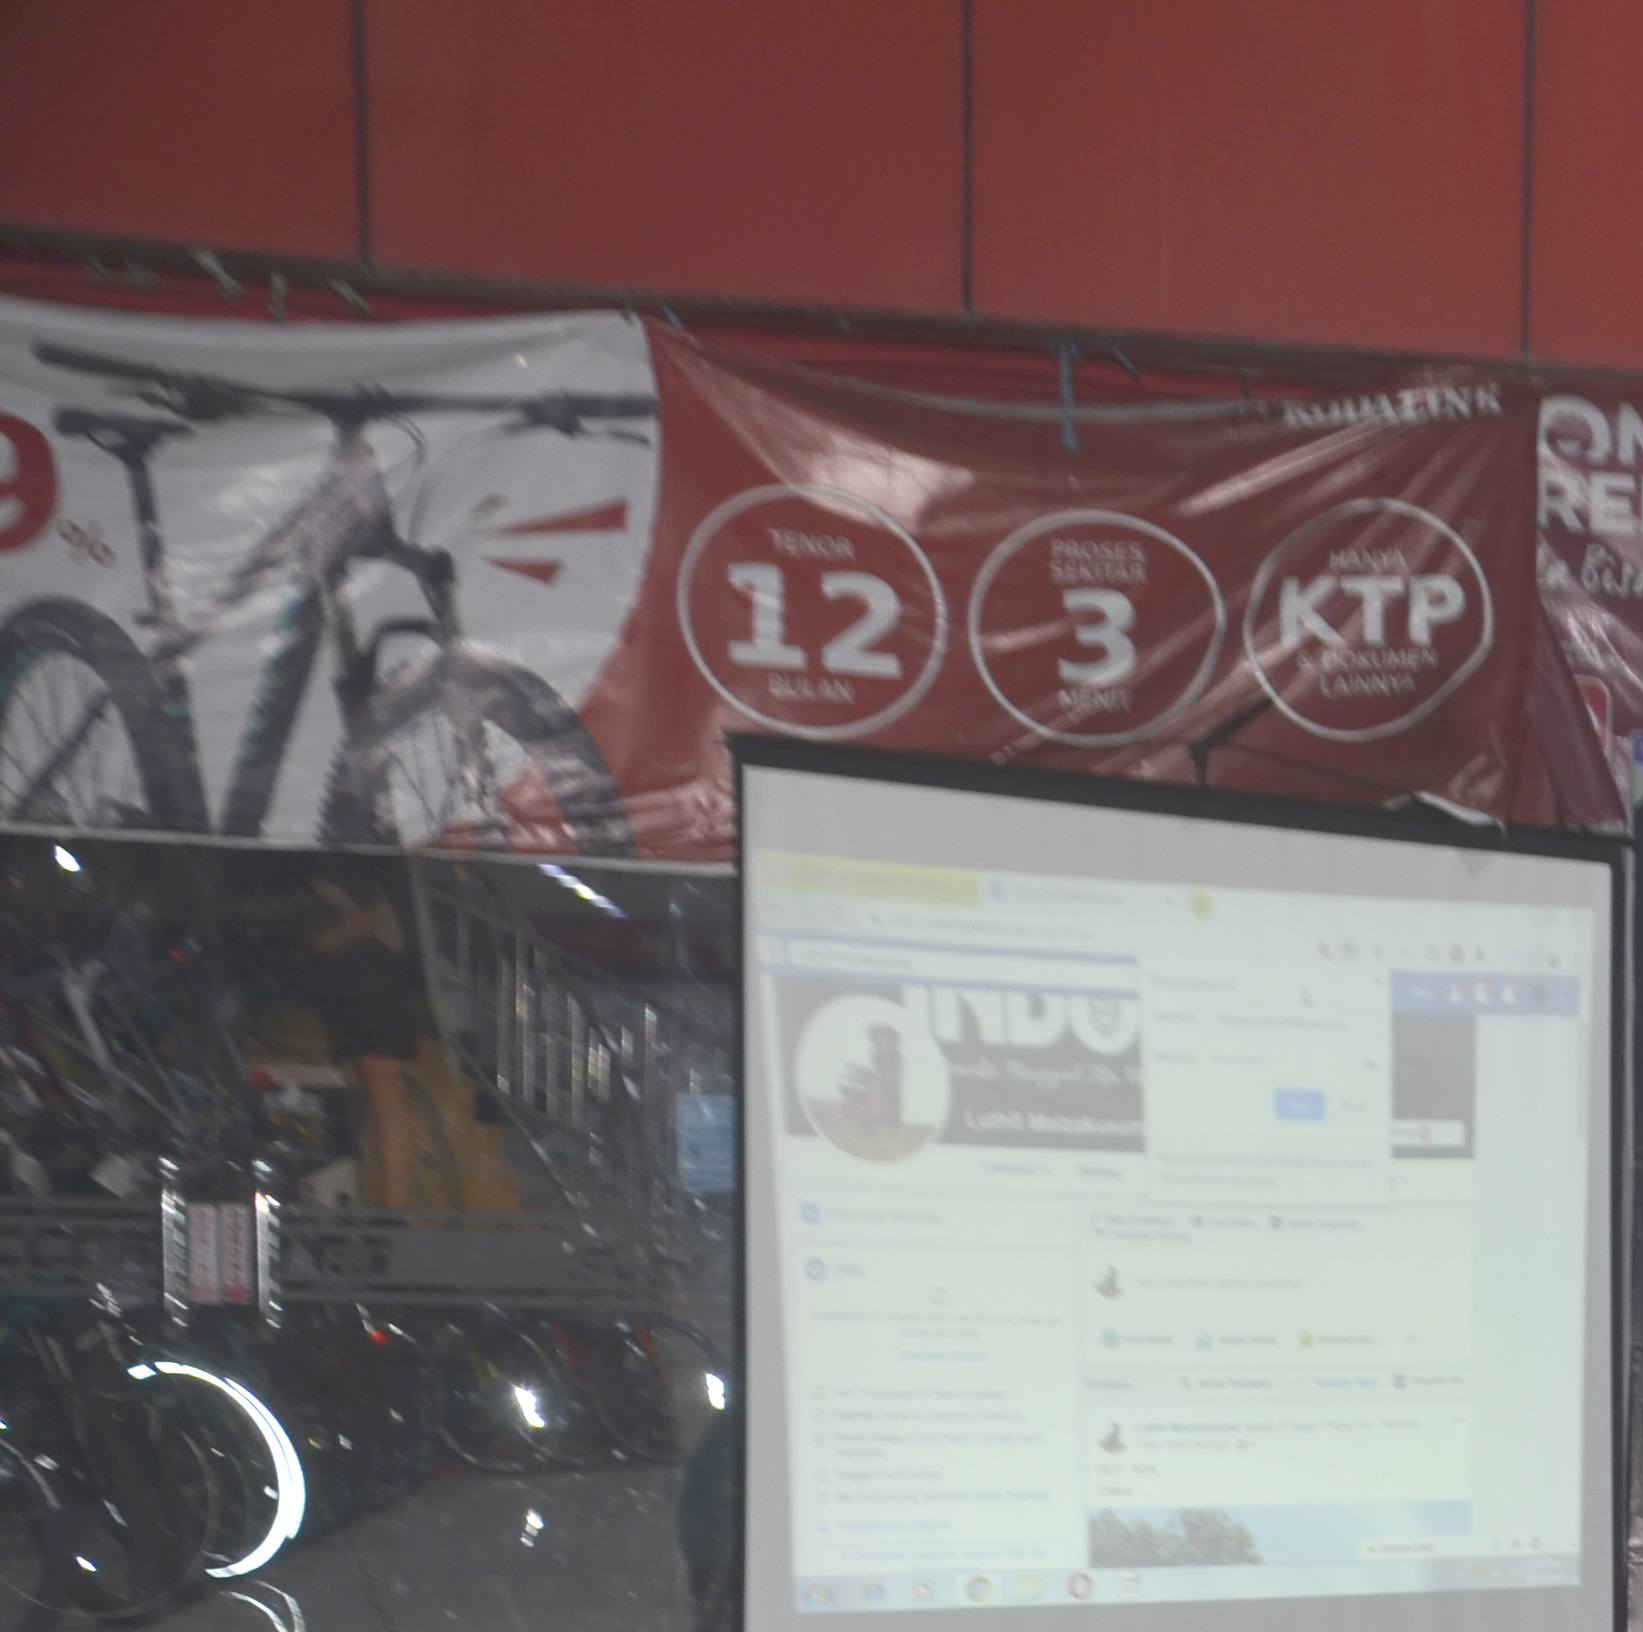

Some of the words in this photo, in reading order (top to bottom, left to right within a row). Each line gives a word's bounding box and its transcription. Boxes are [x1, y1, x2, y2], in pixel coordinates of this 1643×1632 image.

[768, 528, 857, 562] TENOR
[1051, 539, 1145, 562] PROSES
[1050, 563, 1148, 584] SEKITAR
[727, 562, 902, 680] 12
[1280, 574, 1466, 647] KTP
[1058, 587, 1136, 688] 3
[768, 672, 856, 704] BULAN
